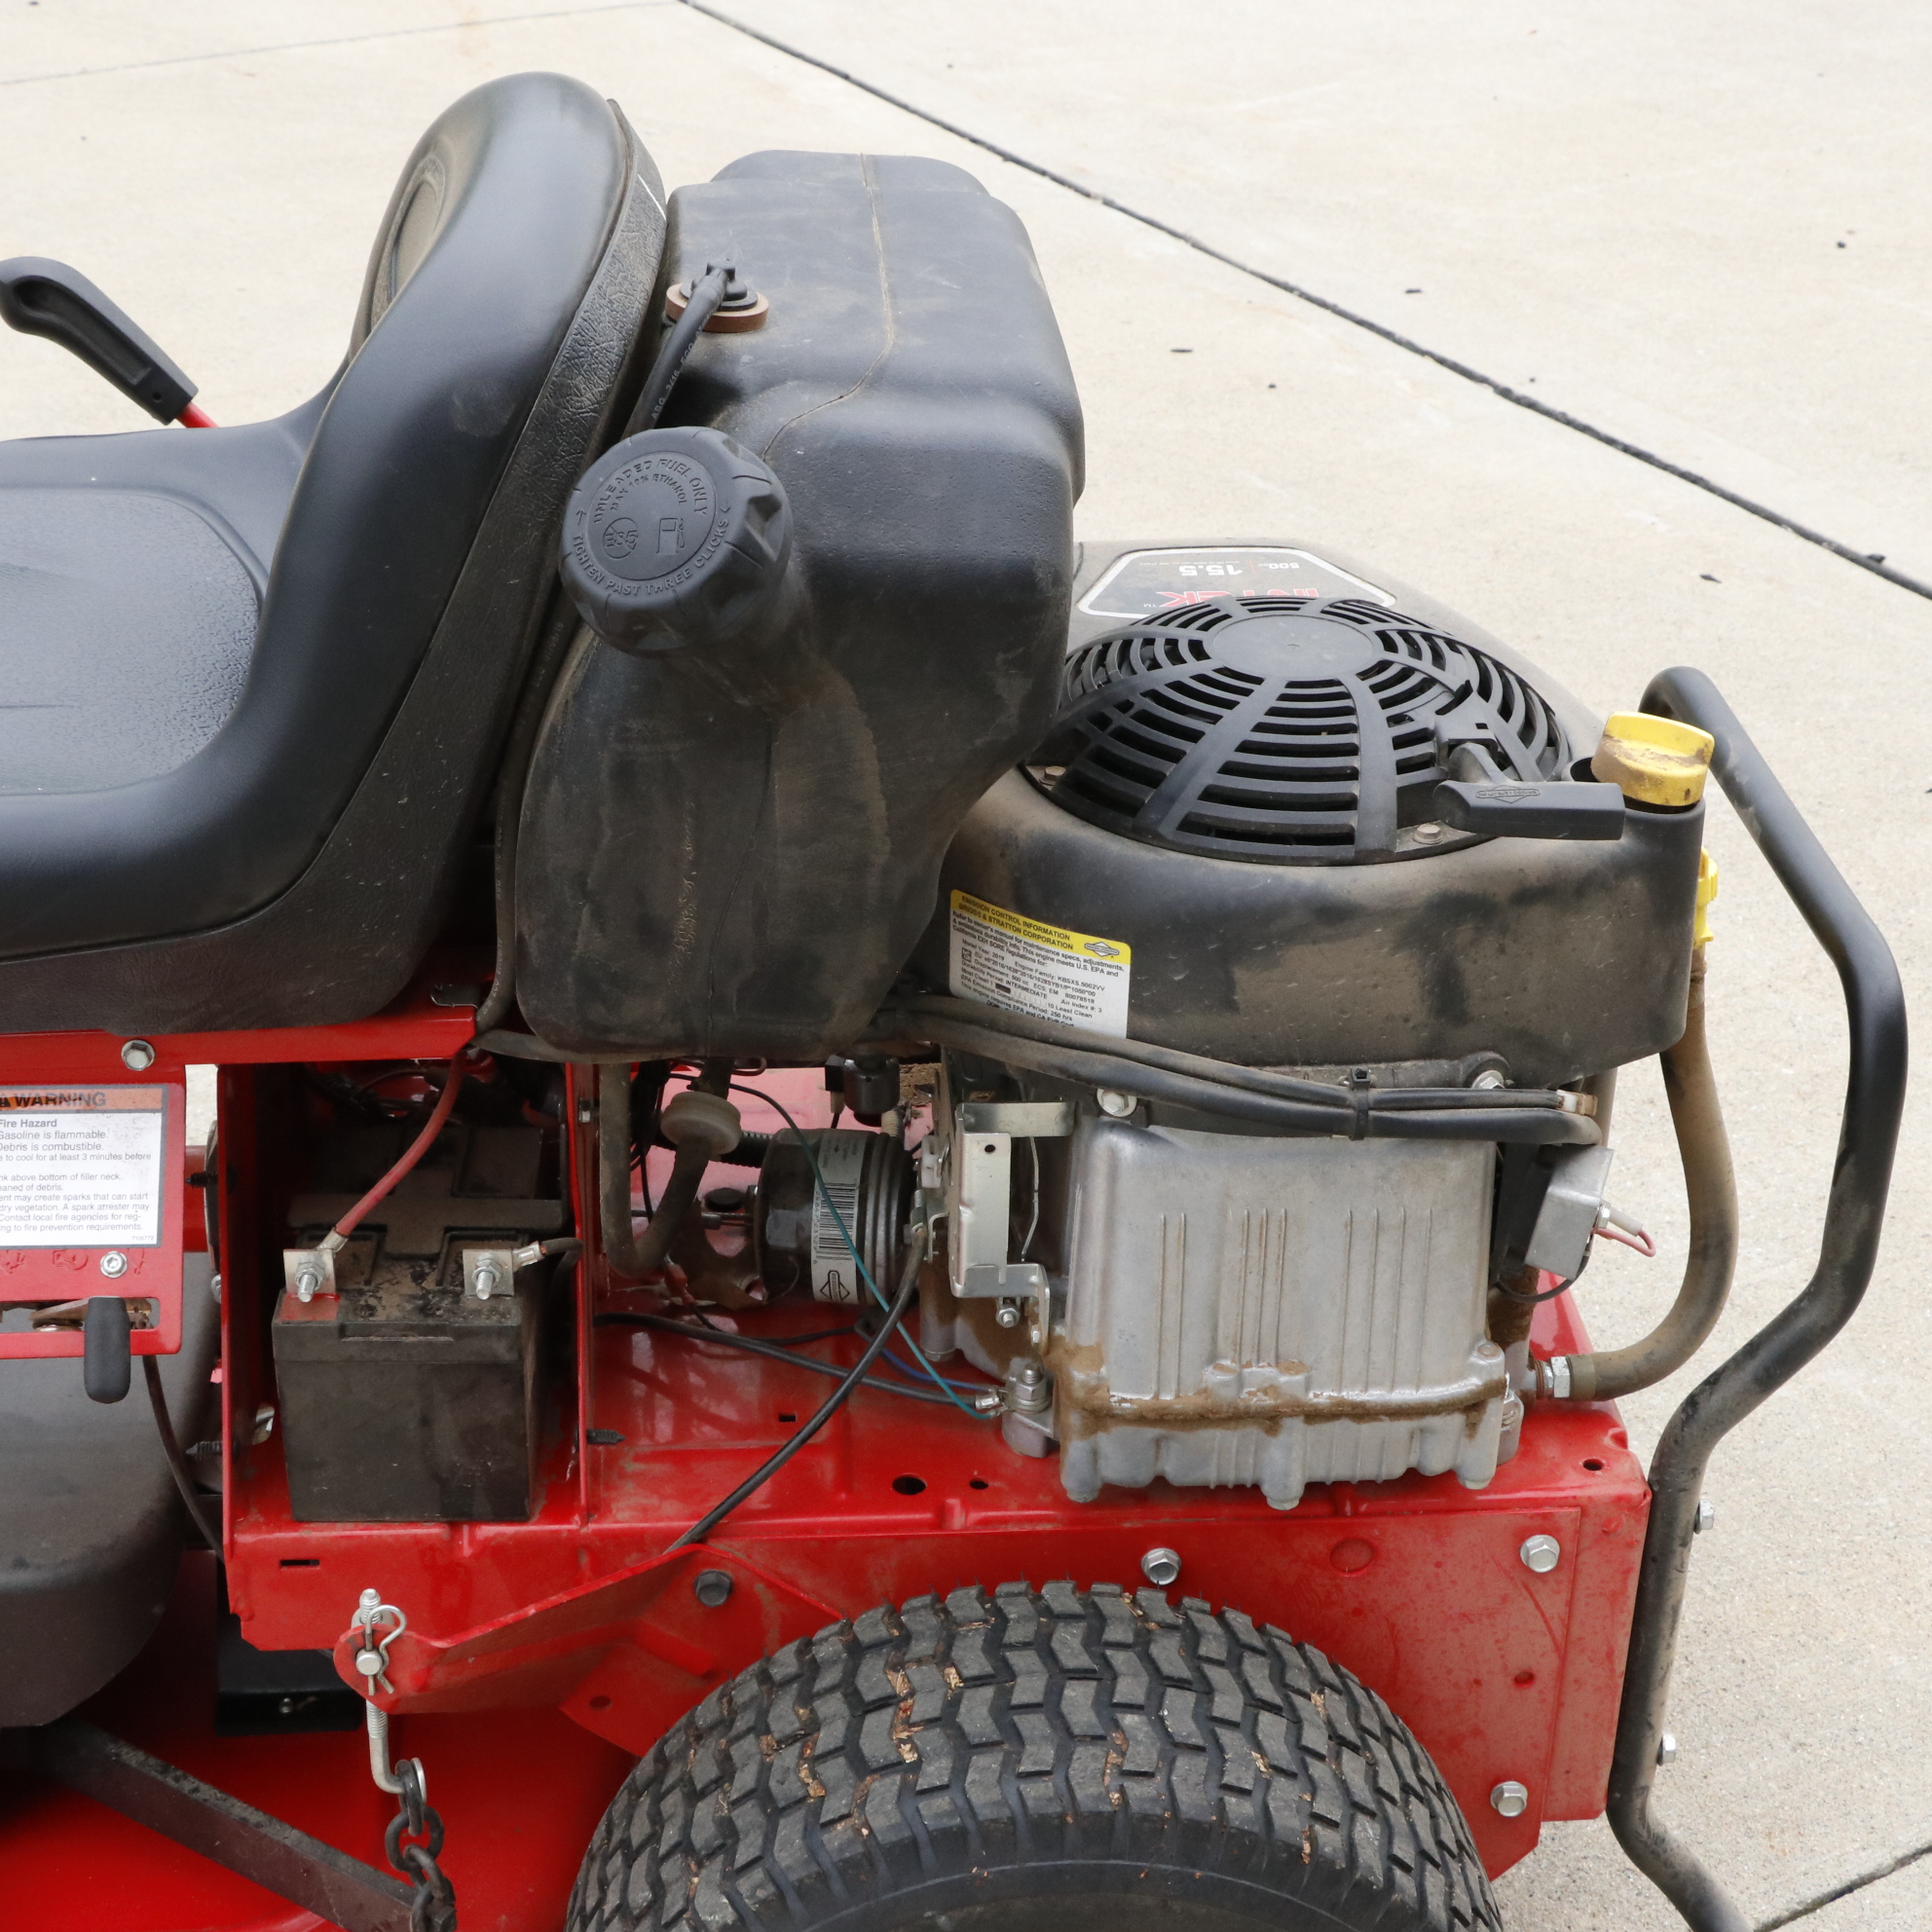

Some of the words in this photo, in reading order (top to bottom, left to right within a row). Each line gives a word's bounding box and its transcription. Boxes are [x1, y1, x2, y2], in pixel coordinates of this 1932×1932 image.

[594, 460, 652, 524] UNLEADED
[657, 459, 691, 478] FUEL
[689, 477, 708, 515] ONLY
[573, 532, 605, 584] TIGHTEN
[605, 580, 641, 596] PAST
[645, 568, 693, 594] THREE
[694, 519, 729, 568] CLICKS
[1179, 564, 1243, 576] 15.5
[962, 895, 989, 912] EMISSION
[991, 907, 1021, 925] CONTROL
[1023, 920, 1069, 941] INFORMATION
[959, 902, 981, 917] BRIGGS
[988, 915, 1021, 933] STRATTON
[1023, 928, 1072, 950] CORPORATION
[977, 935, 987, 944] EXH
[989, 941, 1004, 951] SORE
[1006, 947, 1035, 964] regulations
[984, 931, 1007, 946] durability
[1022, 946, 1033, 955] This
[1035, 951, 1054, 963] engine
[1056, 959, 1074, 968] meets
[1076, 962, 1088, 971] U.S.
[994, 928, 1013, 940] manual
[1023, 940, 1059, 956] maintenance
[1061, 952, 1080, 963] specs,
[1083, 957, 1123, 972] adjustments,
[962, 938, 976, 949] Model
[1015, 961, 1033, 973] Engine
[1034, 968, 1055, 980] Family:
[1011, 974, 1021, 982] 500
[1006, 979, 1046, 999] INTERMEDIATE
[1072, 1001, 1088, 1010] Index
[996, 990, 1027, 1007] Compliance
[1050, 1010, 1060, 1018] 250
[1013, 1004, 1023, 1013] EPA
[1025, 1009, 1035, 1017] and
[1055, 1004, 1072, 1014] Least
[1074, 1009, 1092, 1019] Clean
[14, 1092, 107, 1108] WARNING
[20, 1119, 57, 1128] Hazard
[0, 1131, 40, 1139] Gasoline
[43, 1131, 51, 1139] is
[55, 1130, 108, 1139] flammable.
[31, 1142, 39, 1151] is
[42, 1142, 104, 1151] combustible.
[63, 1193, 91, 1202] sparks
[15, 1204, 60, 1213] vegetation.
[71, 1203, 94, 1212] spark
[71, 1213, 108, 1222] agencies
[125, 1213, 141, 1221] reg-
[40, 1224, 83, 1232] prevention
[86, 1223, 143, 1232] requirements.
